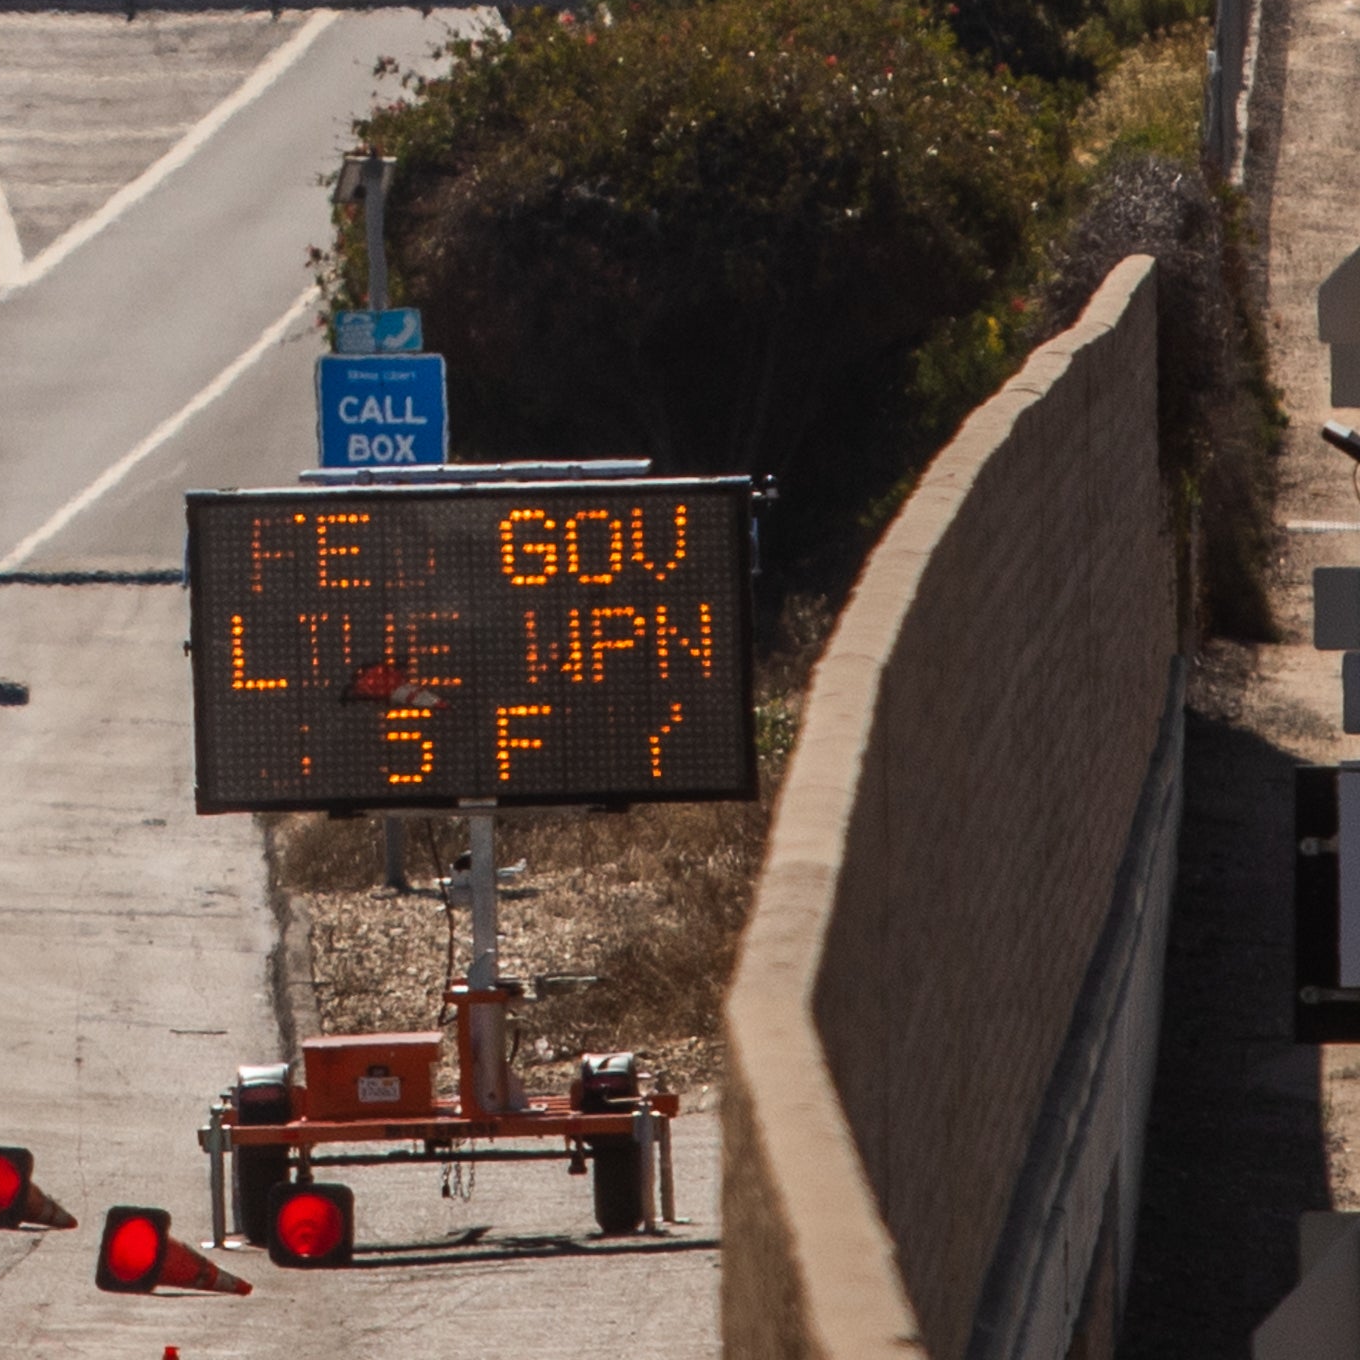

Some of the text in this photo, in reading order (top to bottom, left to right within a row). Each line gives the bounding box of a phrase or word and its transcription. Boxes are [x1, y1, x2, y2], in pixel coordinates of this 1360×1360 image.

[338, 395, 428, 425] CALL
[347, 434, 418, 463] BOX
[499, 504, 687, 586] GOV
